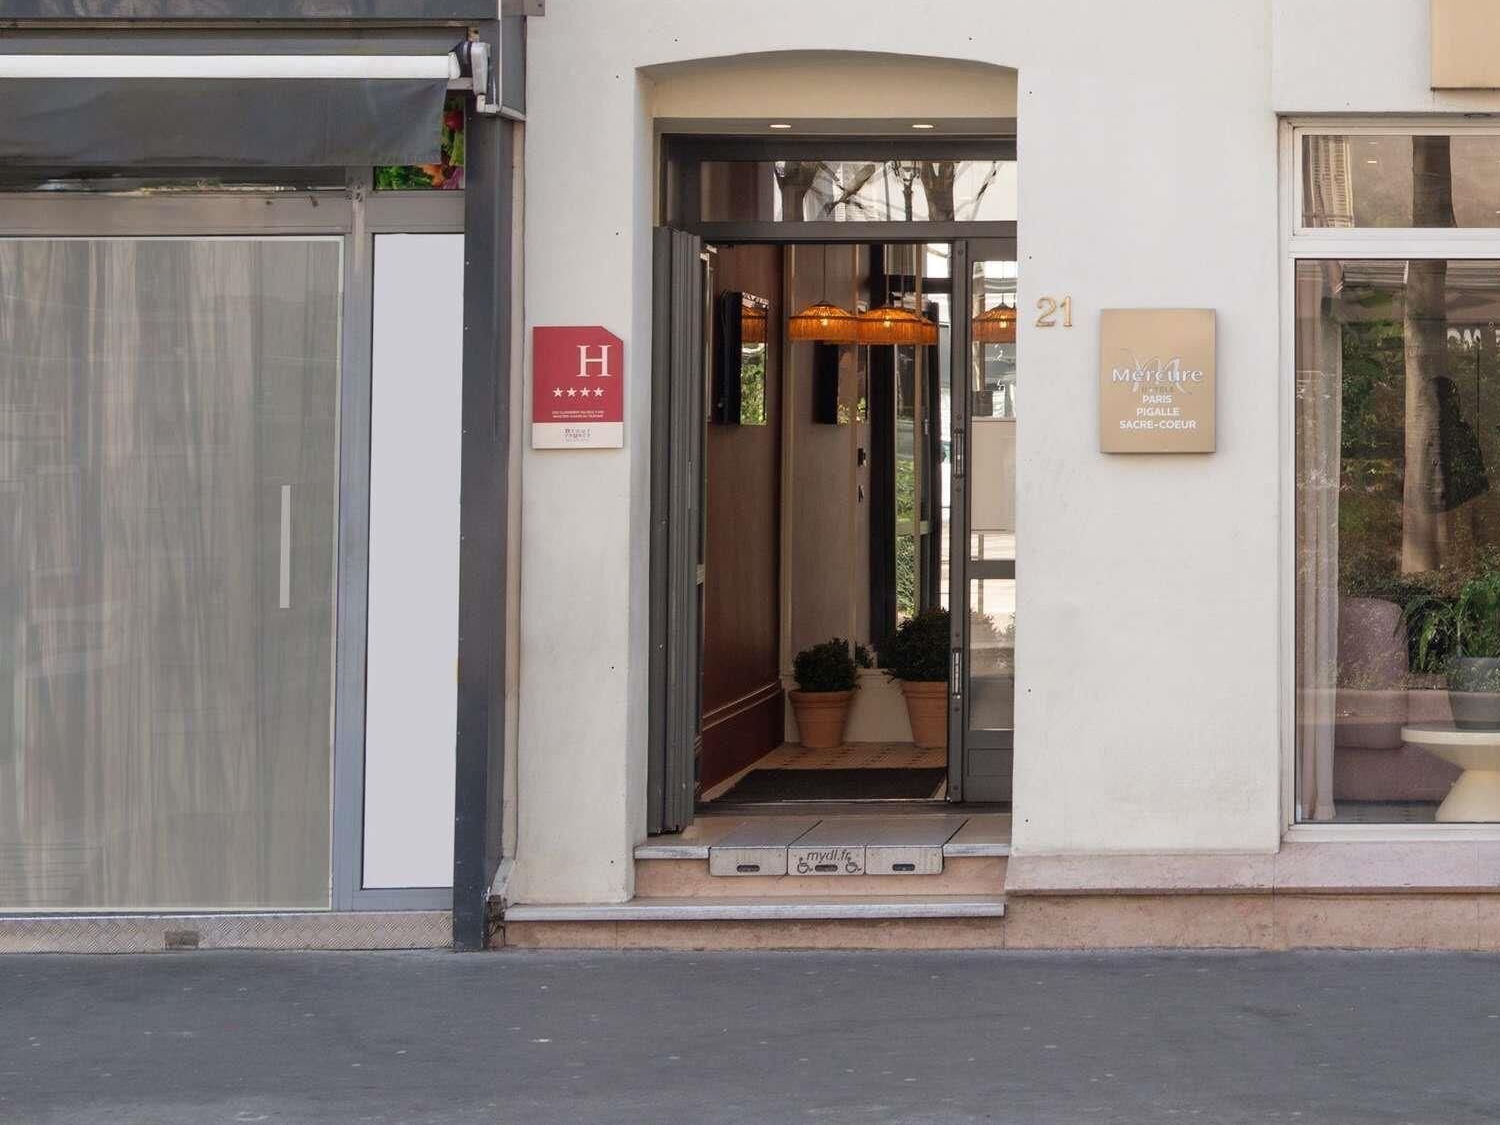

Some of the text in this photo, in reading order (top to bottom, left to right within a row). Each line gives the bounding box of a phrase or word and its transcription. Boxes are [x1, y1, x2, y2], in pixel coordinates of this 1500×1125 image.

[1035, 295, 1073, 327] 21
[576, 344, 613, 377] H
[1112, 368, 1203, 383] Mercure
[1142, 394, 1173, 404] PARIS
[1136, 407, 1180, 417] PIGALLE
[806, 849, 851, 864] mydl.fr
